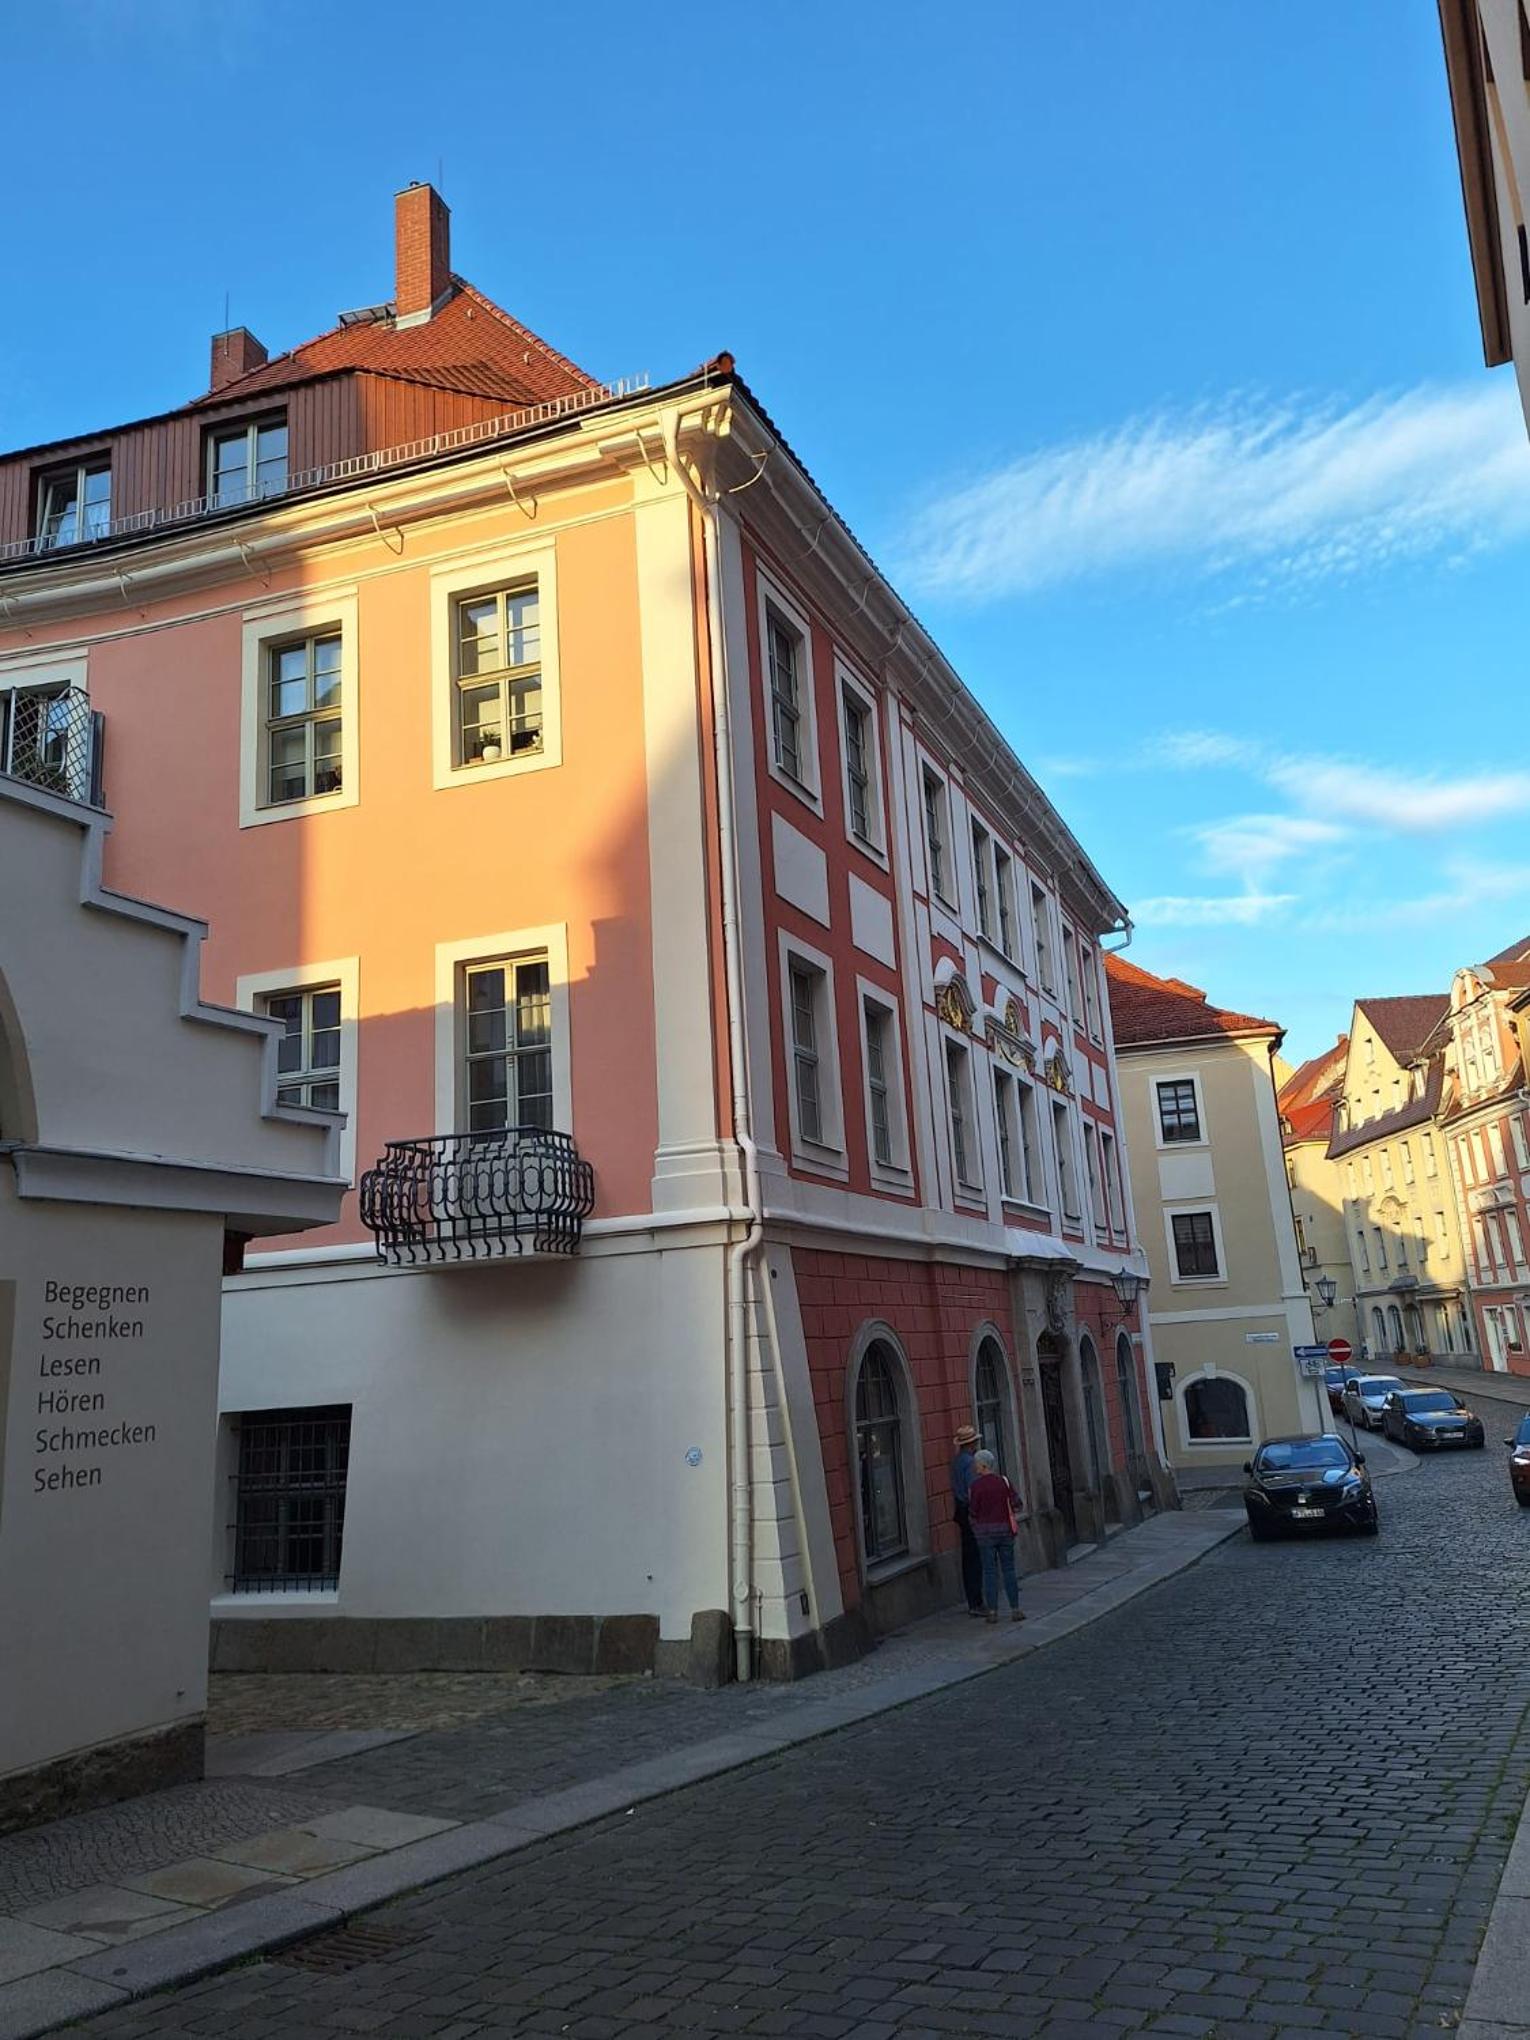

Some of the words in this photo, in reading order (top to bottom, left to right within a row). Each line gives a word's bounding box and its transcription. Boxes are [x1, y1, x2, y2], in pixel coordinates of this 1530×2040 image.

[45, 1280, 150, 1310] Begegnen
[42, 1315, 144, 1339] Schenken
[40, 1354, 101, 1377] Lesen
[38, 1390, 104, 1414] Hören
[35, 1421, 156, 1453] Schmecken
[34, 1465, 102, 1492] Sehen
